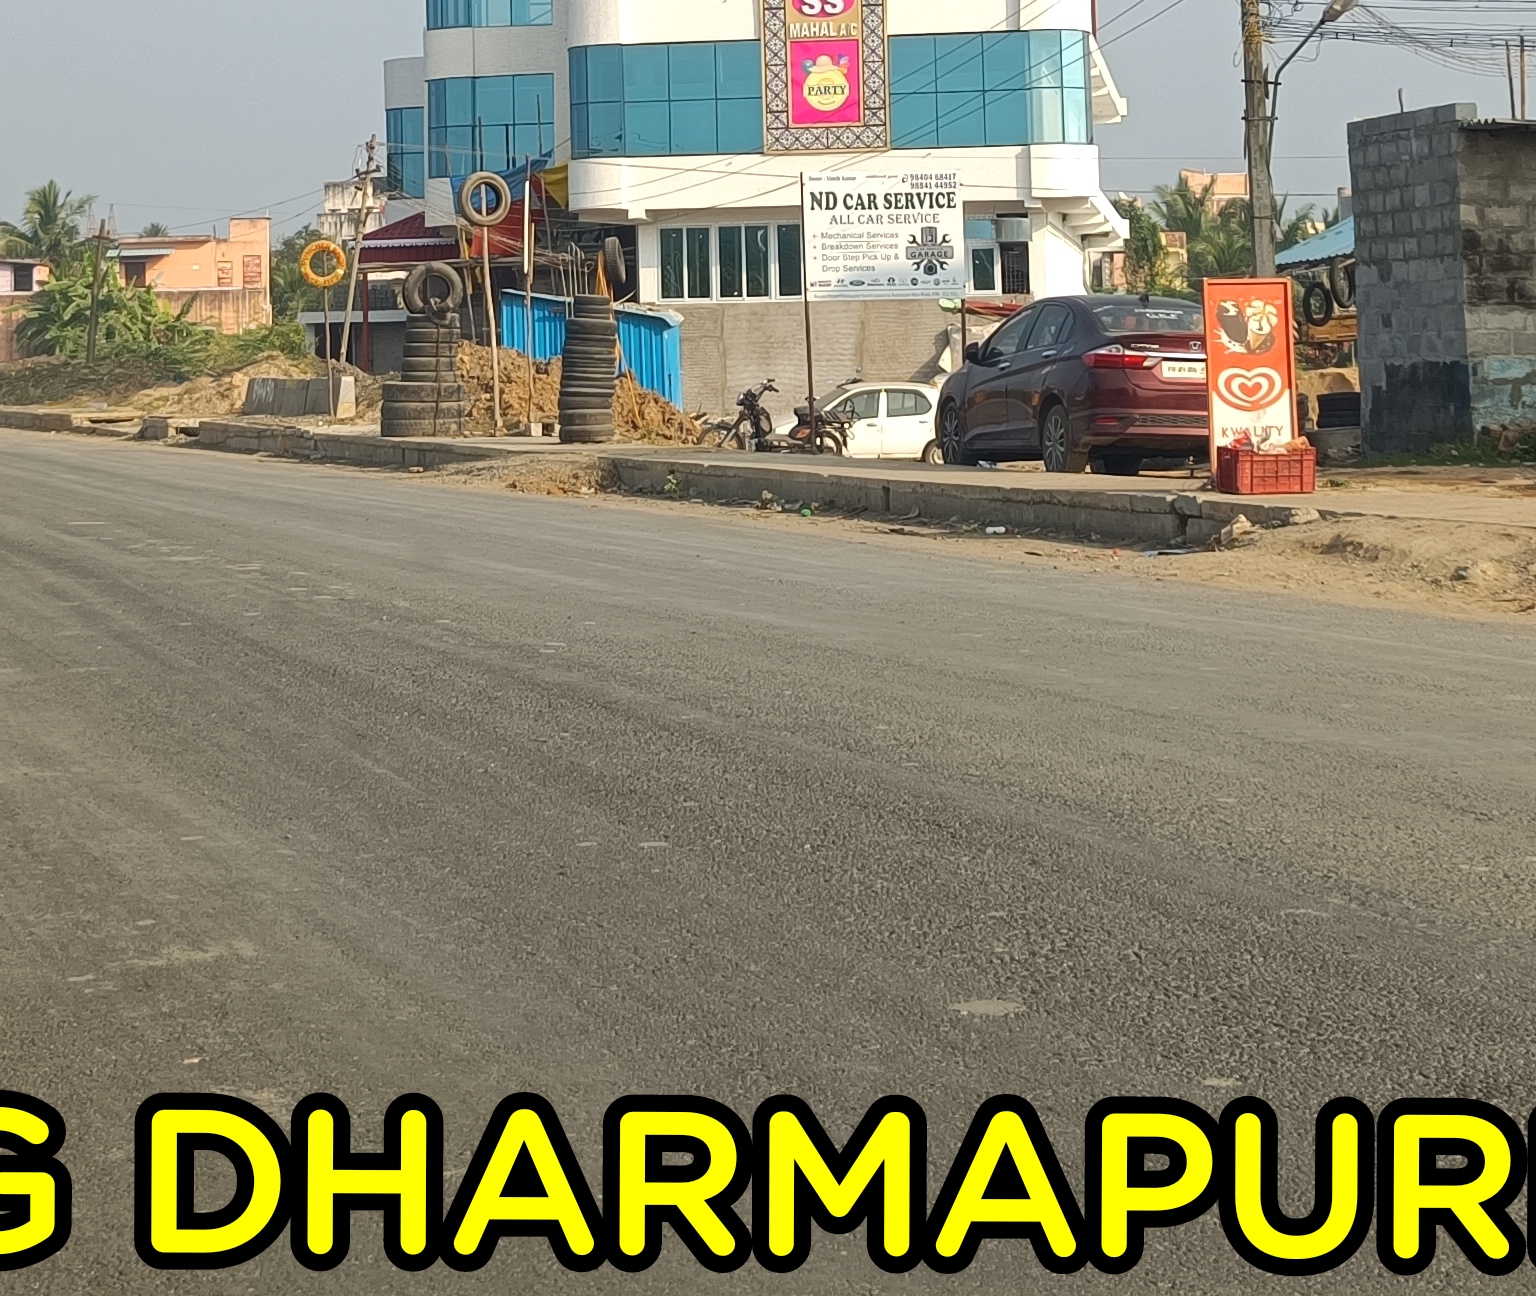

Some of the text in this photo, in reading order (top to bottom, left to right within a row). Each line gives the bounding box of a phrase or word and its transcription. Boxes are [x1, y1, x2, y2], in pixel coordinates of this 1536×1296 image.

[789, 21, 837, 39] MAHAL
[807, 84, 847, 96] PARTY
[809, 191, 957, 211] ND CAR SERVICE
[829, 212, 940, 225] ALL CAR SERVICE
[866, 231, 899, 239] Services
[866, 242, 898, 250] Services
[821, 253, 840, 261] Door
[843, 253, 860, 262] Step
[862, 253, 878, 261] Pick
[880, 253, 891, 262] Up
[821, 264, 876, 273] Drop Services
